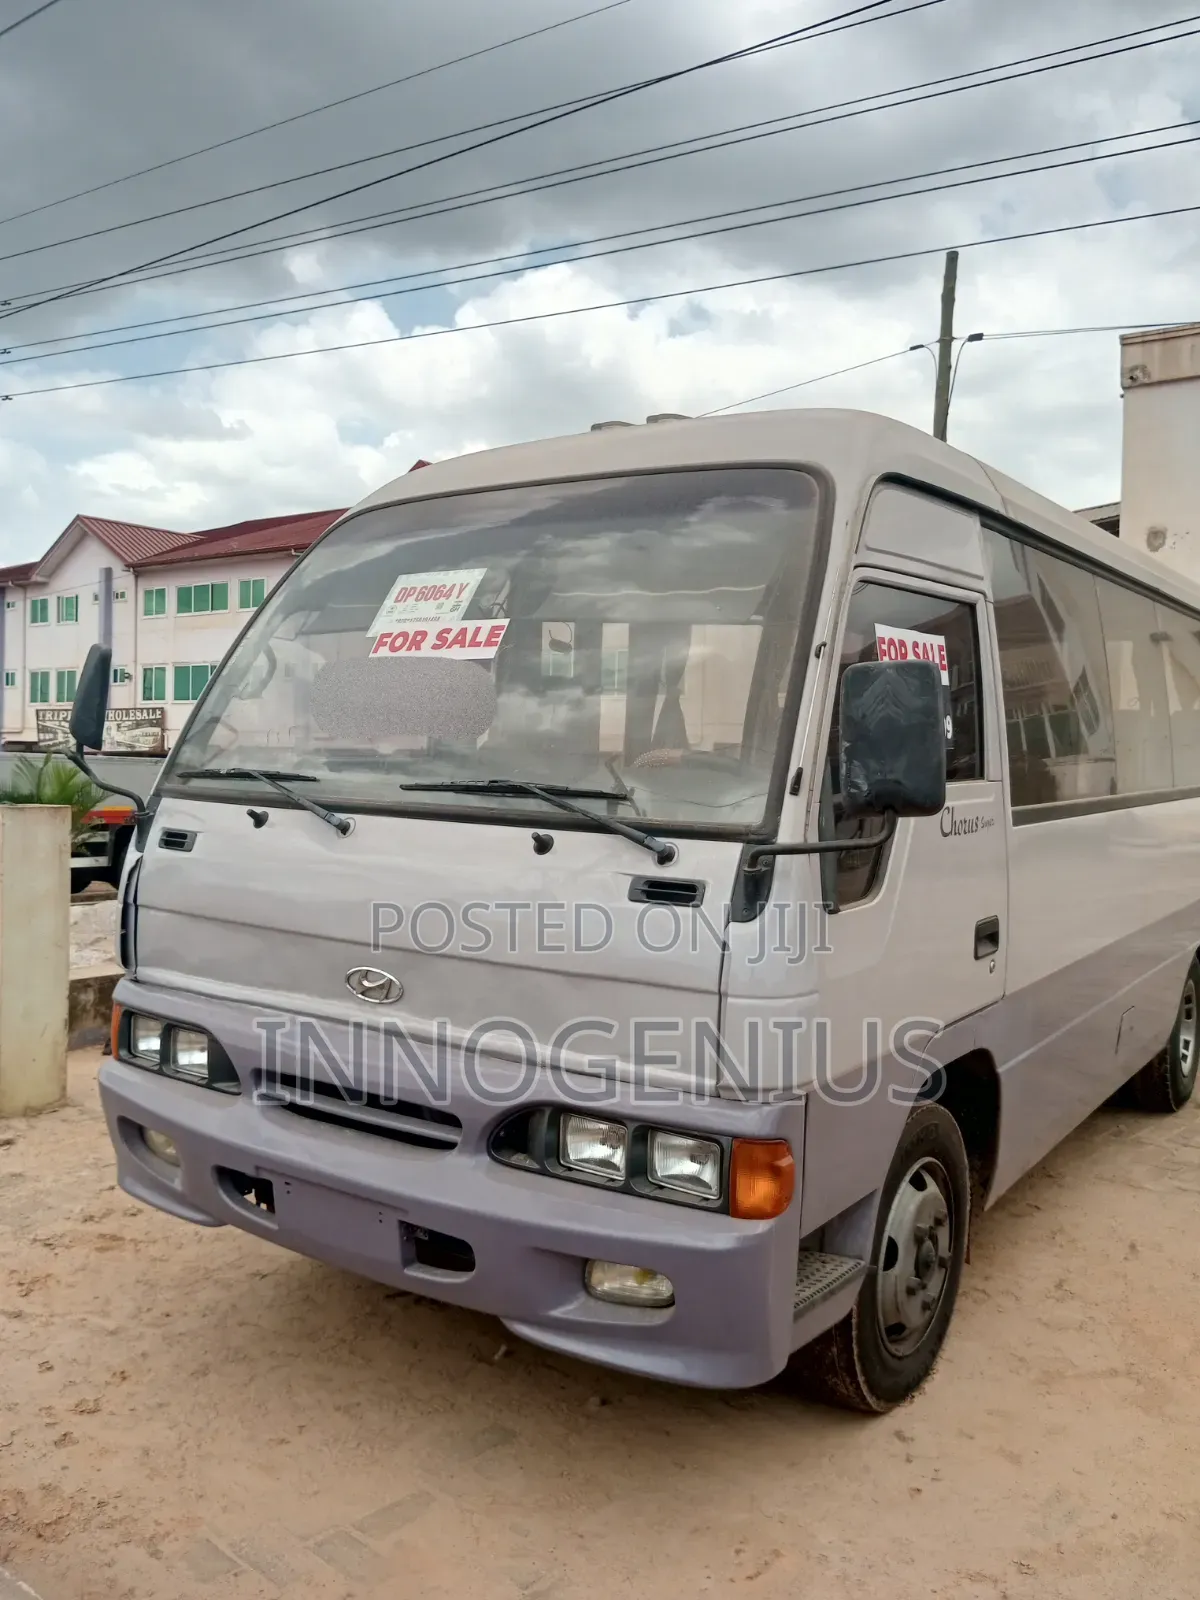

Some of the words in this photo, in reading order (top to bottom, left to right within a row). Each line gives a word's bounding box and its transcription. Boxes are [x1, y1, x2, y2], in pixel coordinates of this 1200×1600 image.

[414, 582, 456, 602] 6064
[456, 582, 470, 600] Y
[371, 630, 428, 654] FOR
[431, 624, 506, 650] SALE
[877, 636, 908, 662] FOR
[105, 708, 162, 721] HOLESALE
[940, 806, 979, 837] Chorus
